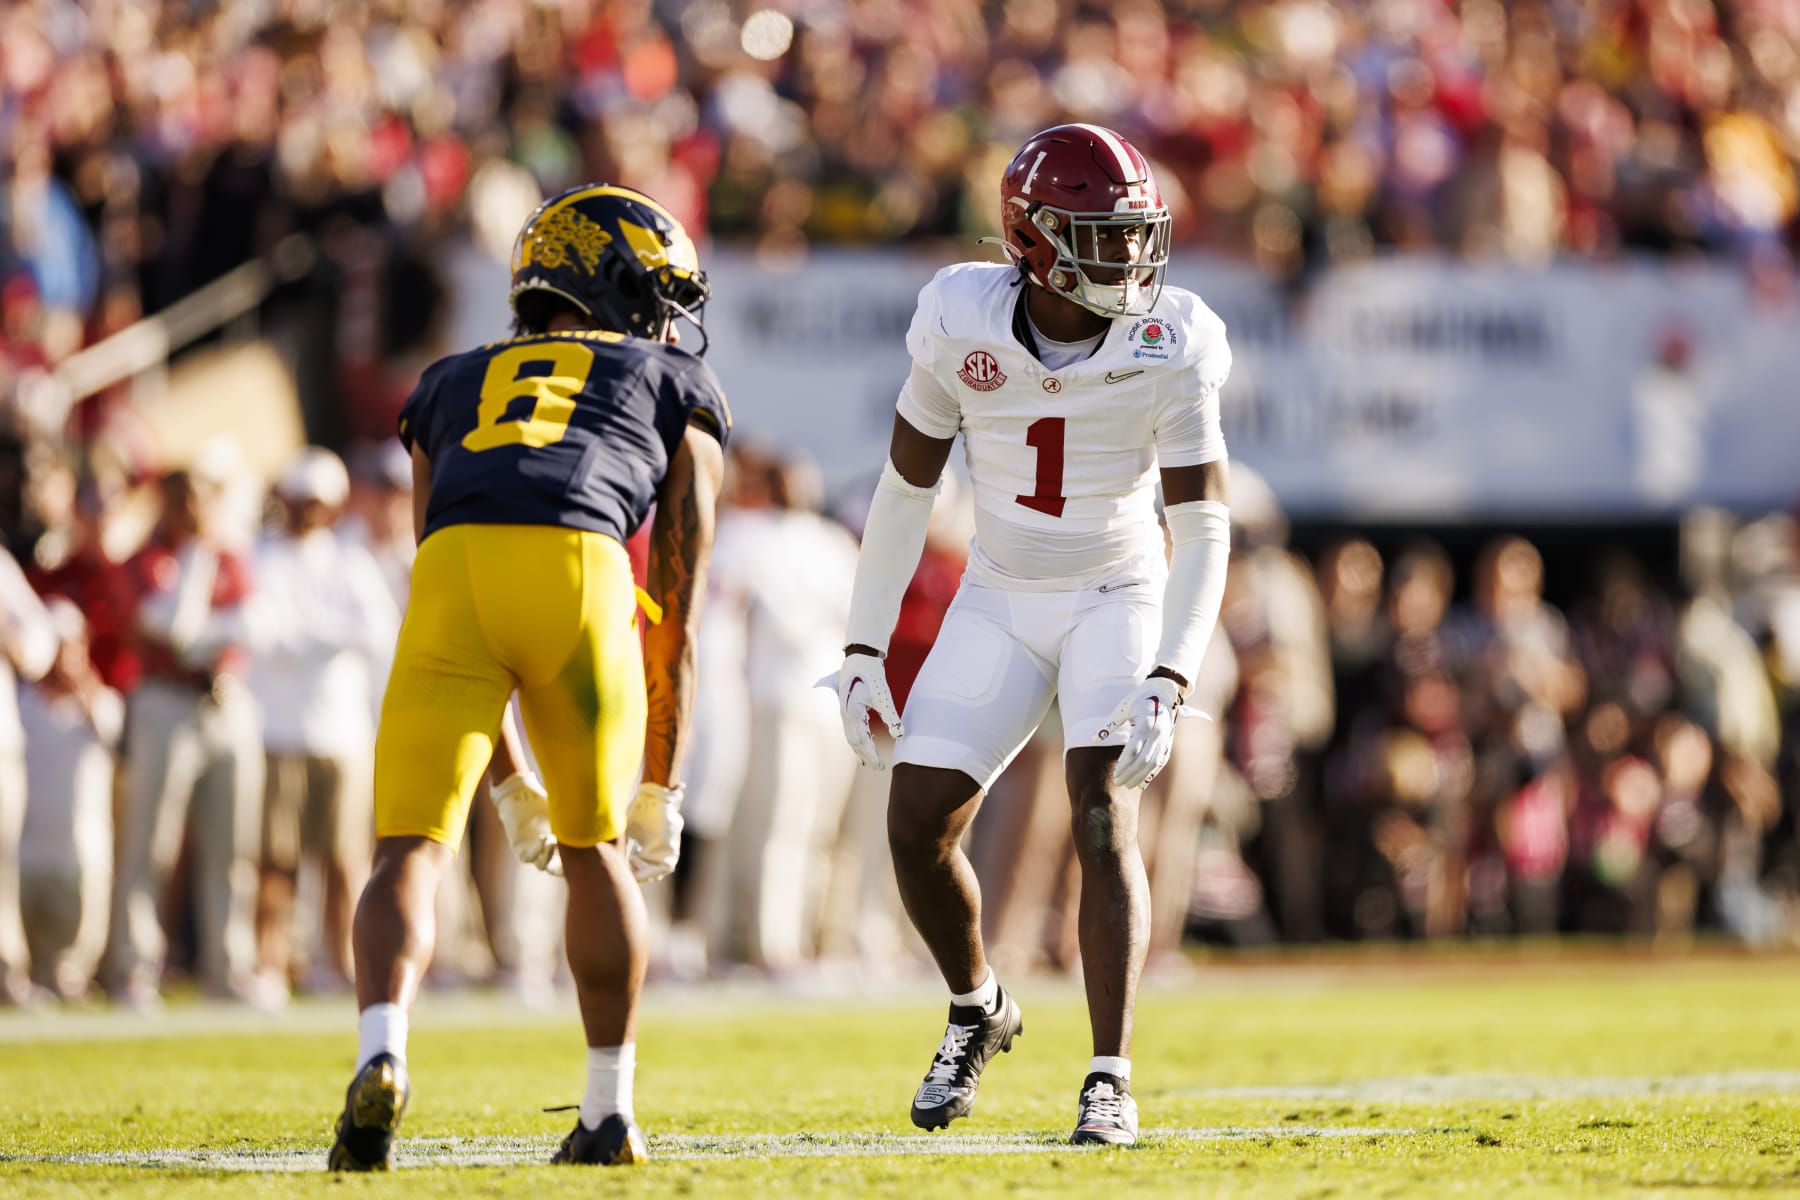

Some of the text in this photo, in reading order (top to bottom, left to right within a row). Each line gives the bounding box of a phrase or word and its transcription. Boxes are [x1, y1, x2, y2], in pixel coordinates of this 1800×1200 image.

[1021, 150, 1048, 195] 1
[1128, 317, 1177, 344] ROSE BOWL GAME
[962, 375, 1002, 391] GRADUATE
[965, 351, 998, 382] SEC
[461, 341, 595, 452] 8
[1015, 416, 1067, 519] 1
